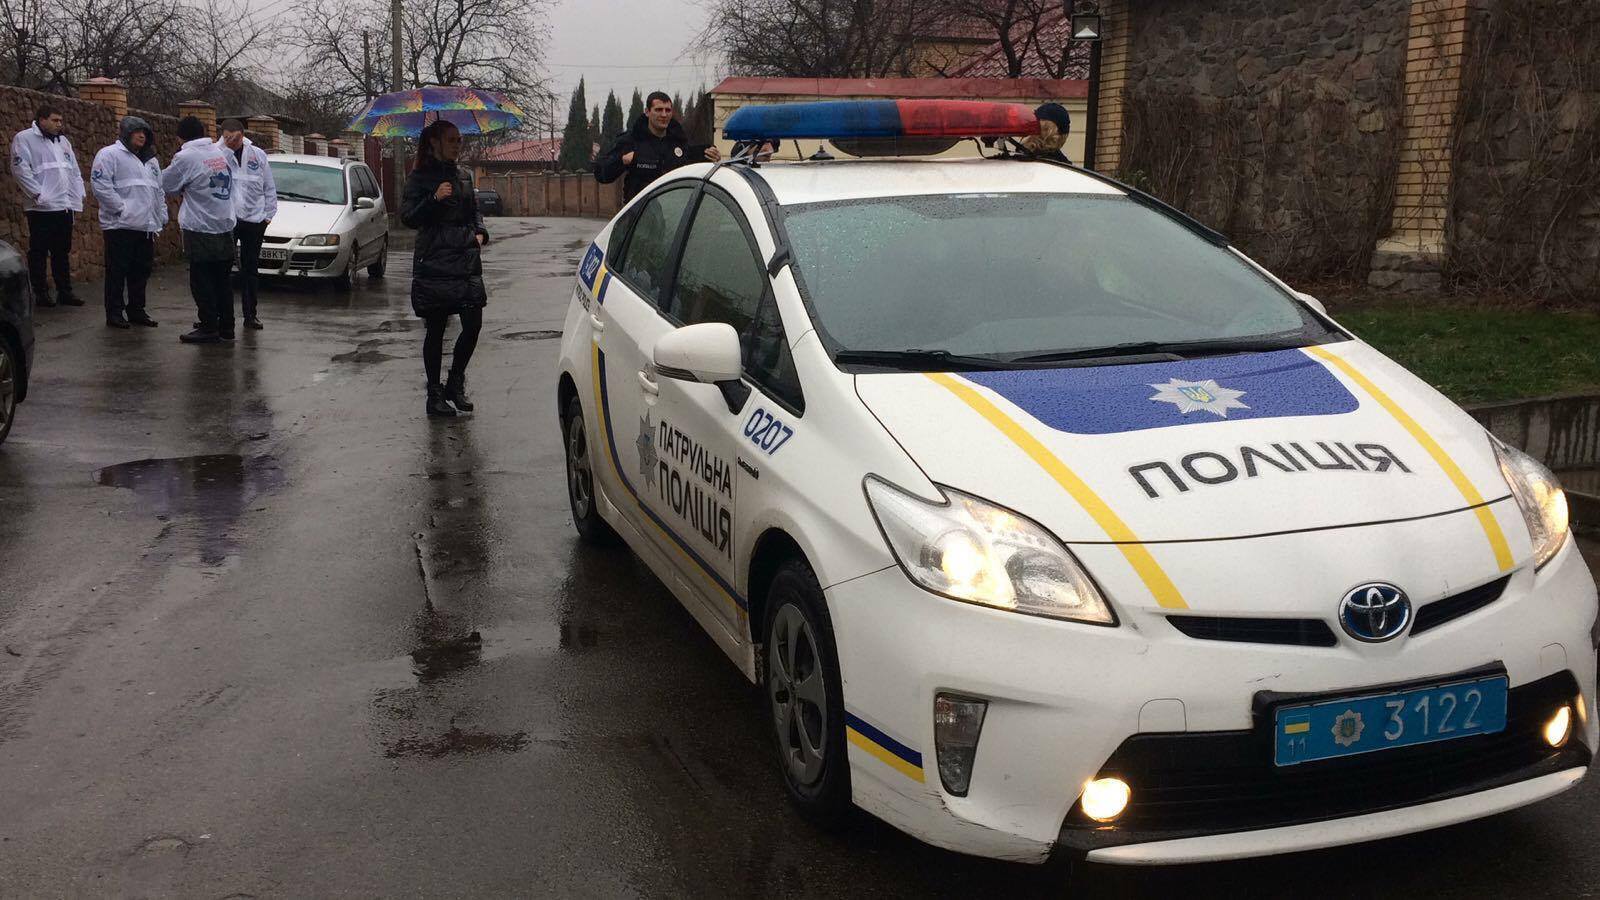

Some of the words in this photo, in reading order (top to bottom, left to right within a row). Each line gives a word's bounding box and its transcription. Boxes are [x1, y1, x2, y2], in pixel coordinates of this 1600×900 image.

[744, 407, 794, 456] 0207
[659, 420, 732, 500] ПАТРУЛЬНА
[1128, 441, 1412, 498] ПОЛІЦІЯ
[659, 460, 732, 561] ПОЛІЦІЯ
[1383, 689, 1482, 741] 3122
[1287, 736, 1307, 754] 11
